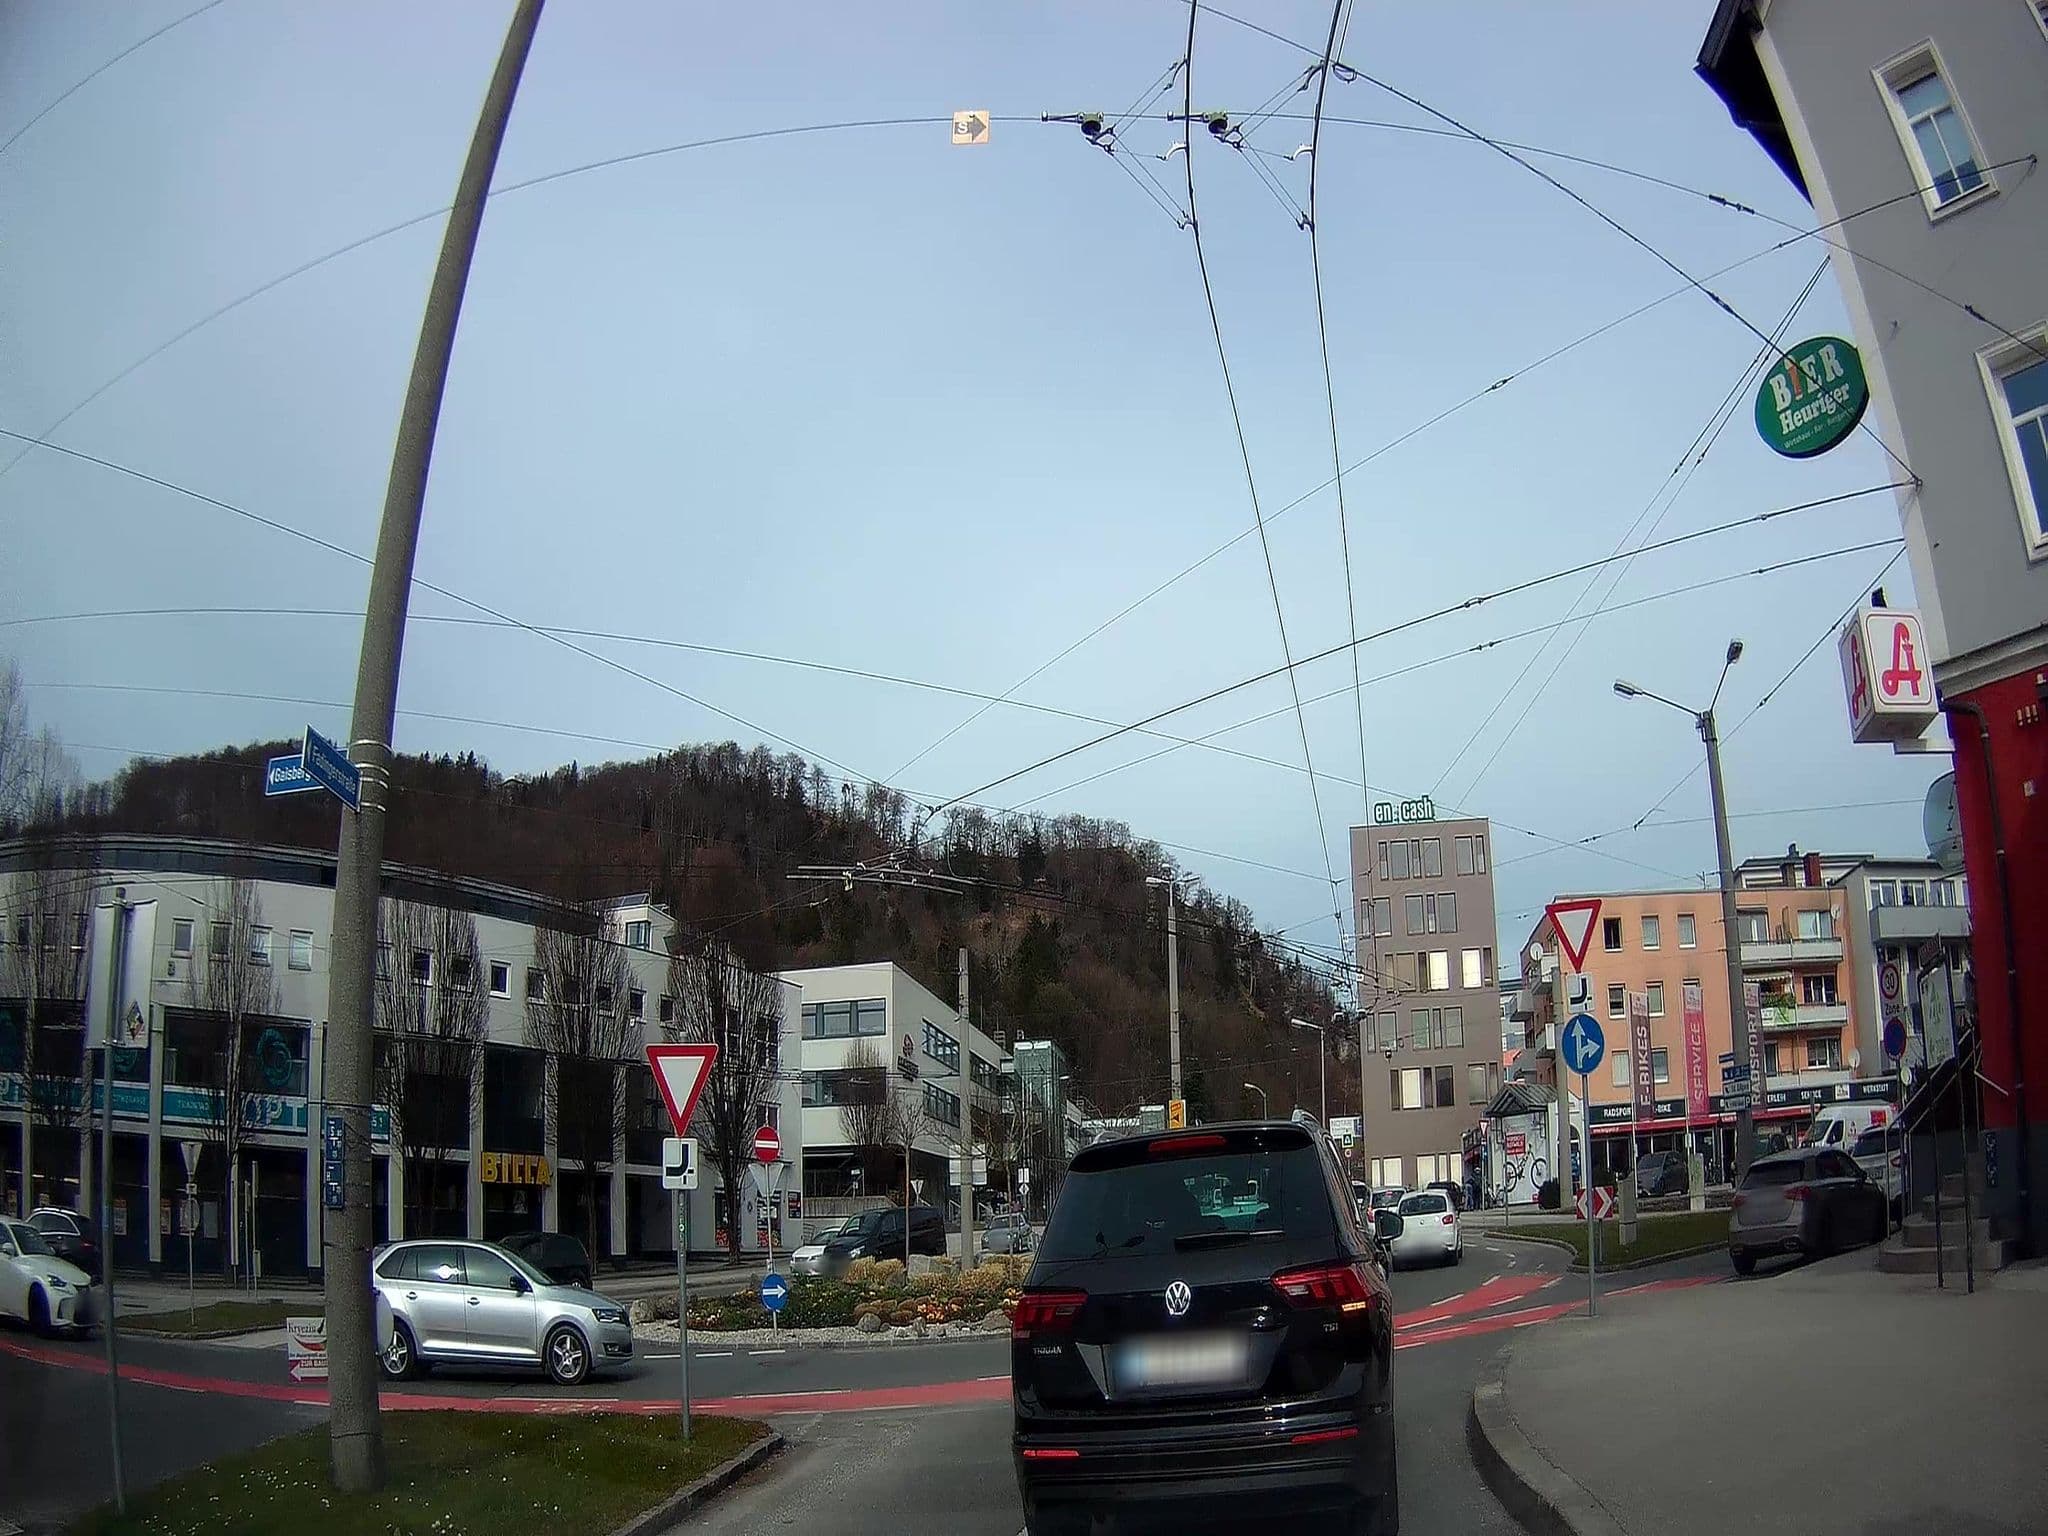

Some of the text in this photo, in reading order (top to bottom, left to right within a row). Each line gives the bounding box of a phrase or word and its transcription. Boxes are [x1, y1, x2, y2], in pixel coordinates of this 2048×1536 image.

[1779, 382, 1850, 435] Heuriger
[1637, 1026, 1651, 1106] E-BIKES
[1691, 1022, 1705, 1101] SERVICE
[1603, 1107, 1632, 1118] RADSPOR
[482, 1152, 550, 1185] BILLA
